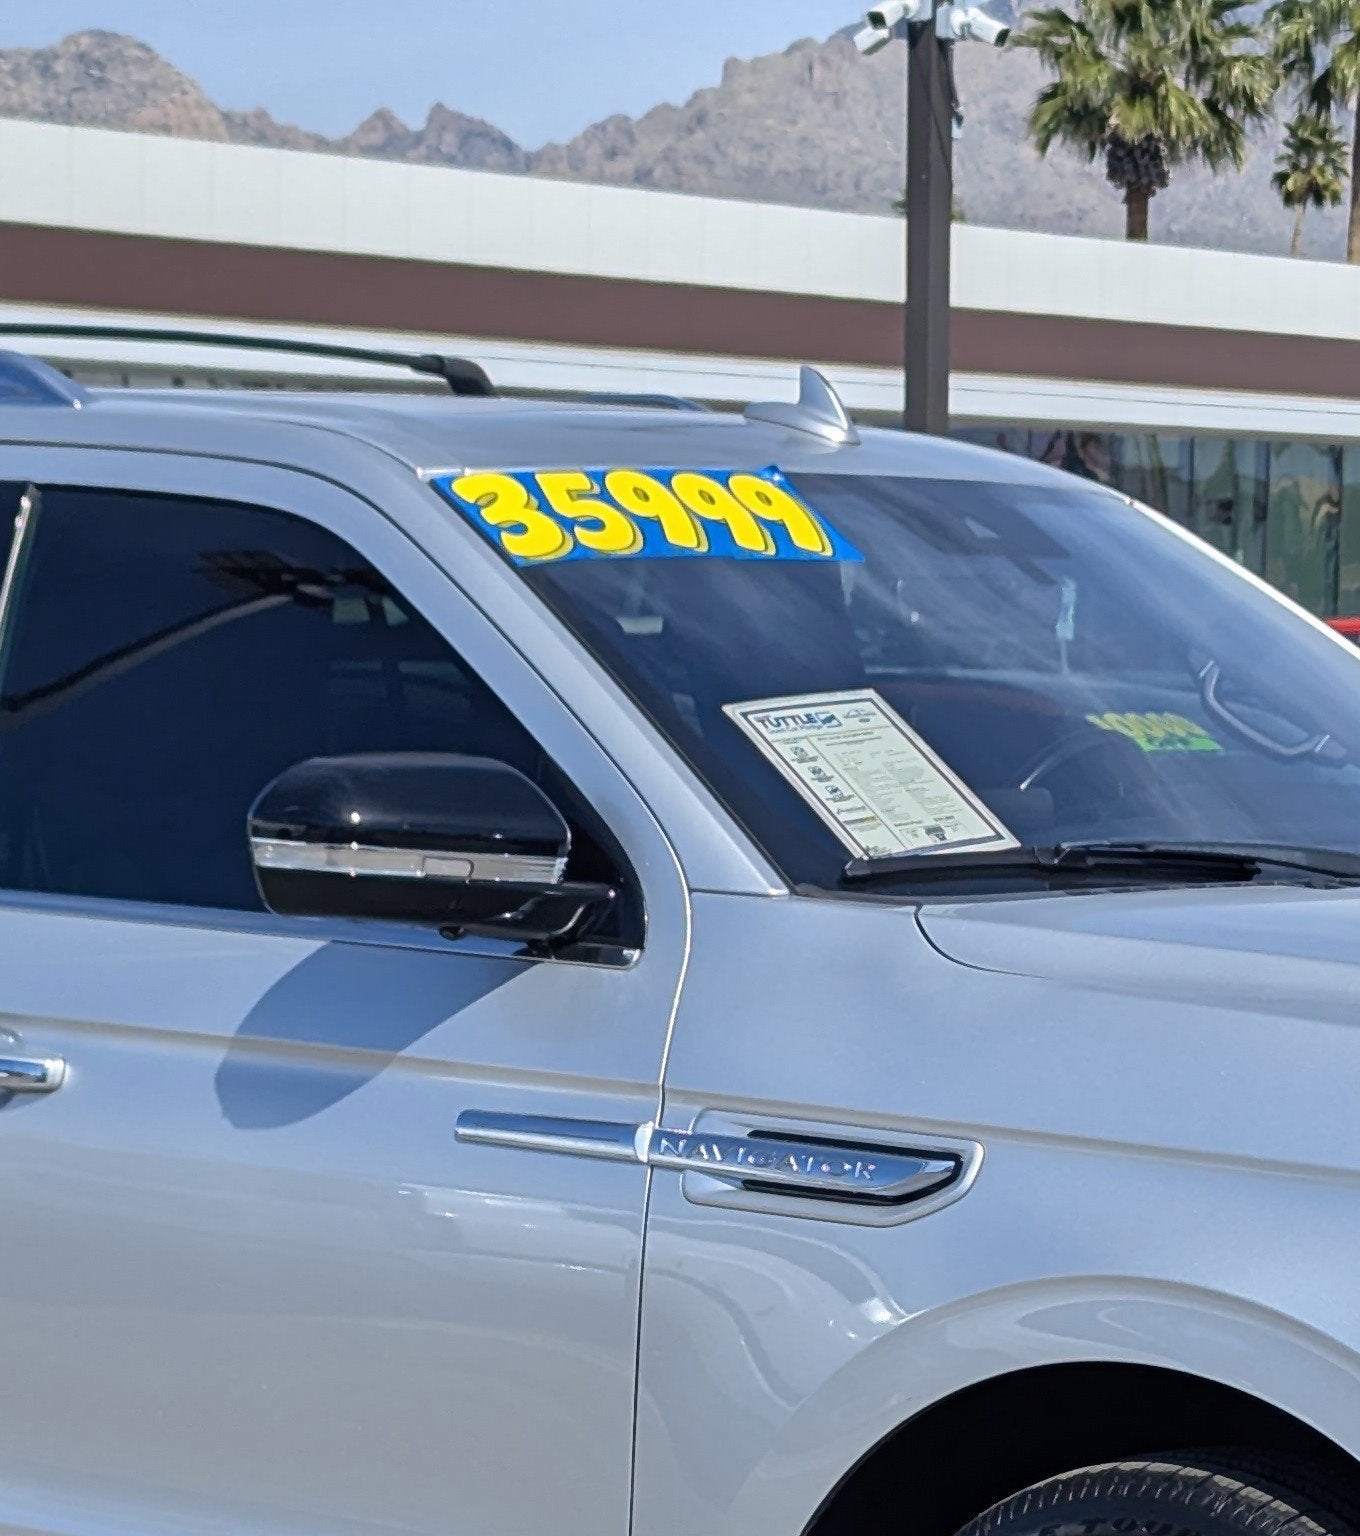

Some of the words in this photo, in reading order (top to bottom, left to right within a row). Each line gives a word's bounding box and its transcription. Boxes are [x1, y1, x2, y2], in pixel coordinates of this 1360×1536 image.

[450, 468, 834, 560] 35999
[756, 712, 820, 730] TUTTLE
[656, 1136, 878, 1181] NAVIGATOR
